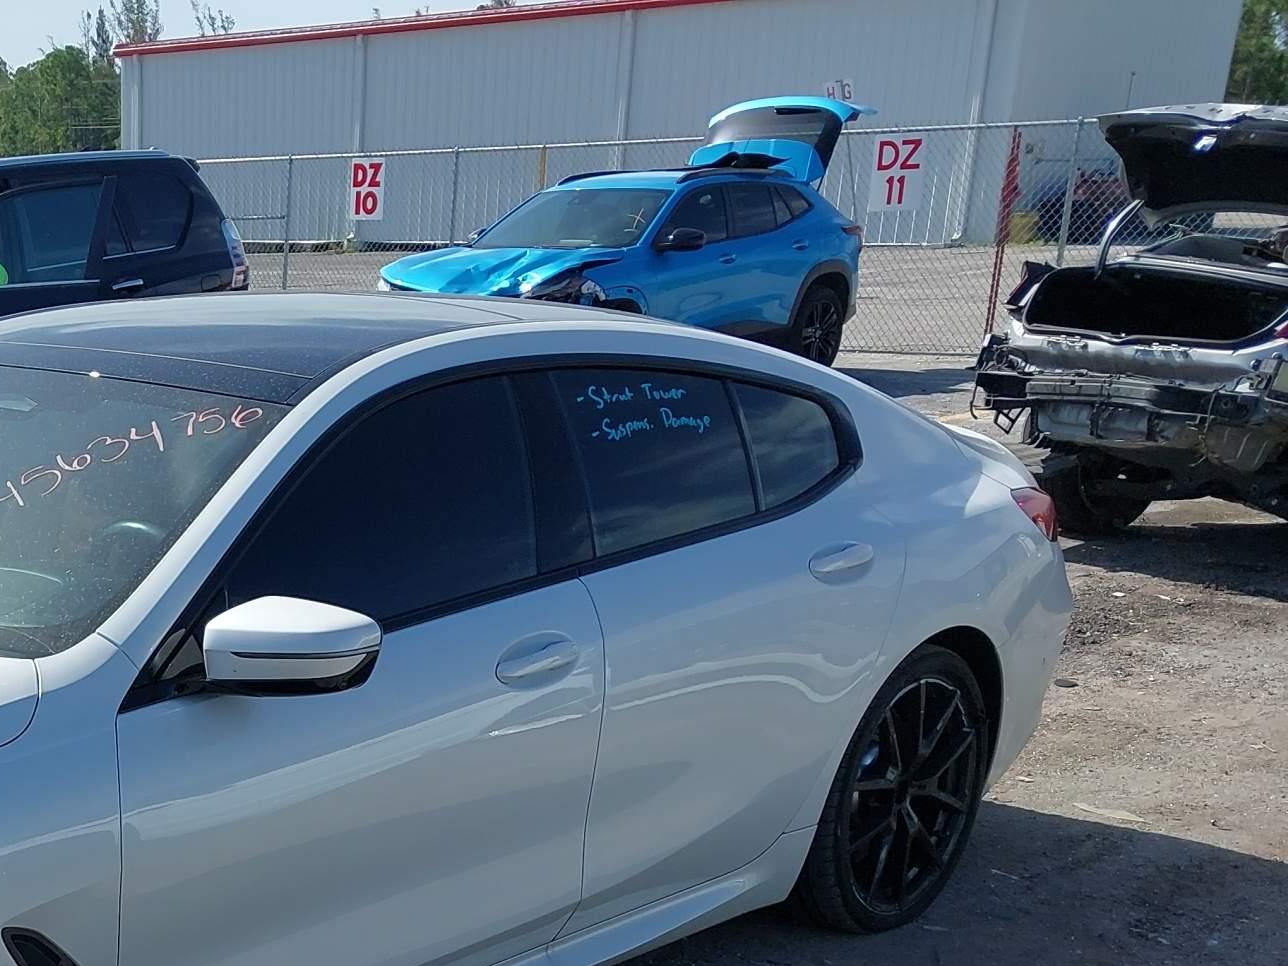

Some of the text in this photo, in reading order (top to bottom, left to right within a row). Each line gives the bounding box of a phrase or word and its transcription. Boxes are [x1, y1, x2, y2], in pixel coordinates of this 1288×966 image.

[877, 138, 923, 171] DZ
[353, 162, 383, 188] DZ
[354, 190, 378, 216] 10
[885, 175, 906, 206] 11
[640, 383, 687, 400] Tower
[659, 407, 711, 433] Damage
